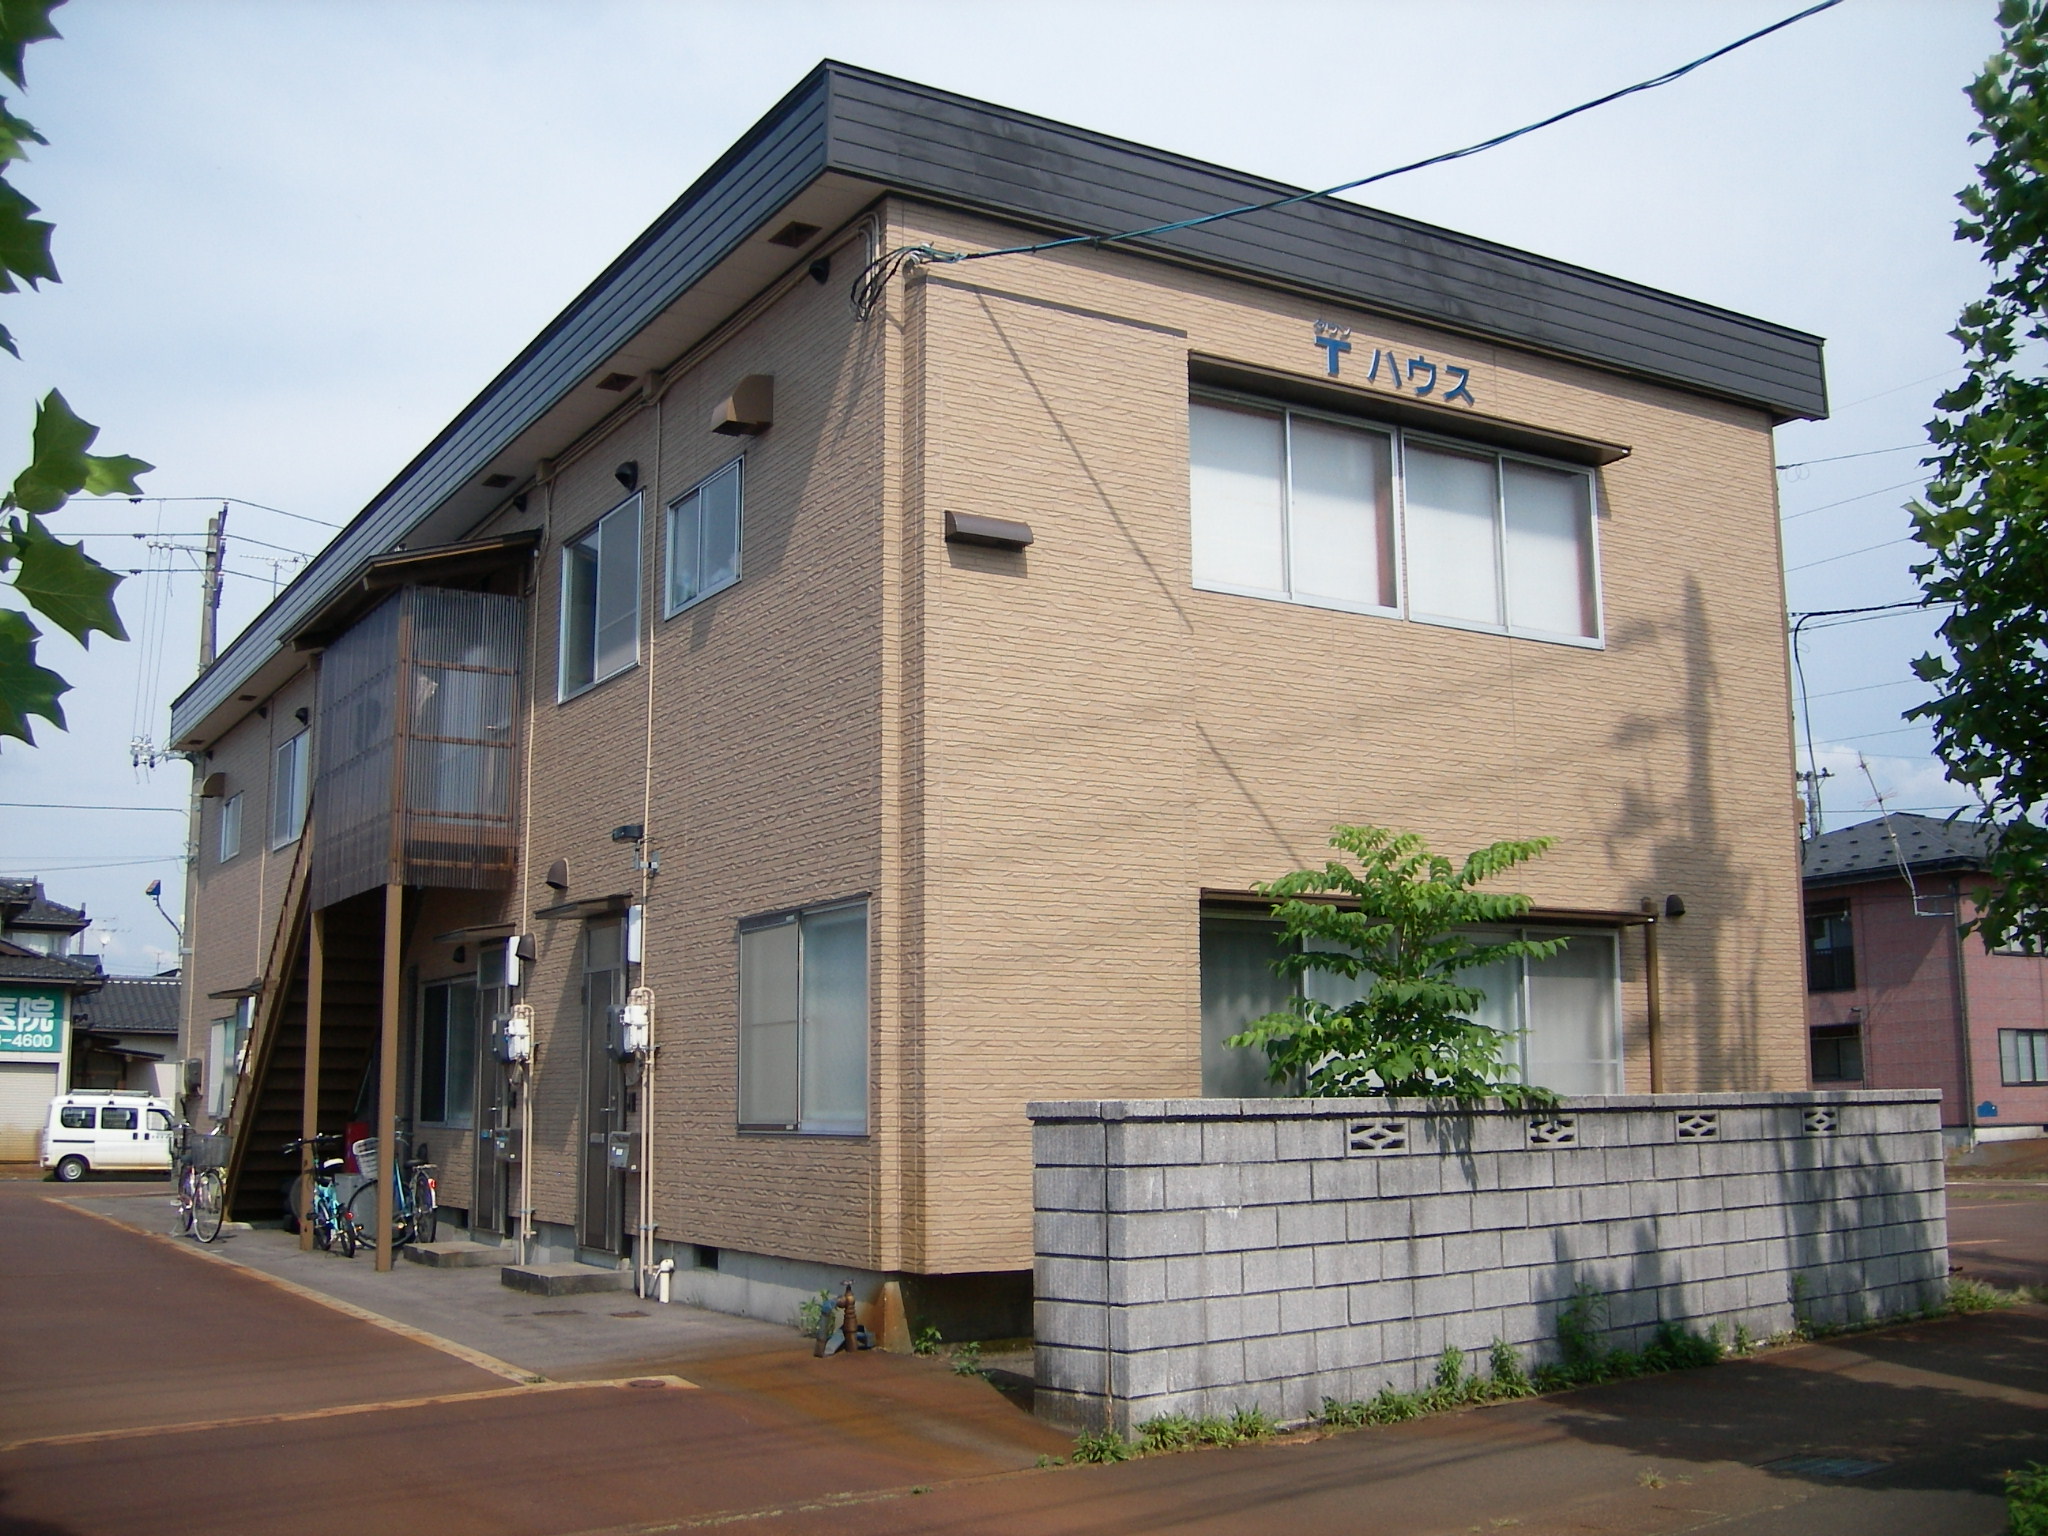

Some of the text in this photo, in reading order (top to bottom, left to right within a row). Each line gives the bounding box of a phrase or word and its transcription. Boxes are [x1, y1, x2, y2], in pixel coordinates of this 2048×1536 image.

[1366, 348, 1475, 406] ハウス
[0, 1033, 53, 1048] -4600
